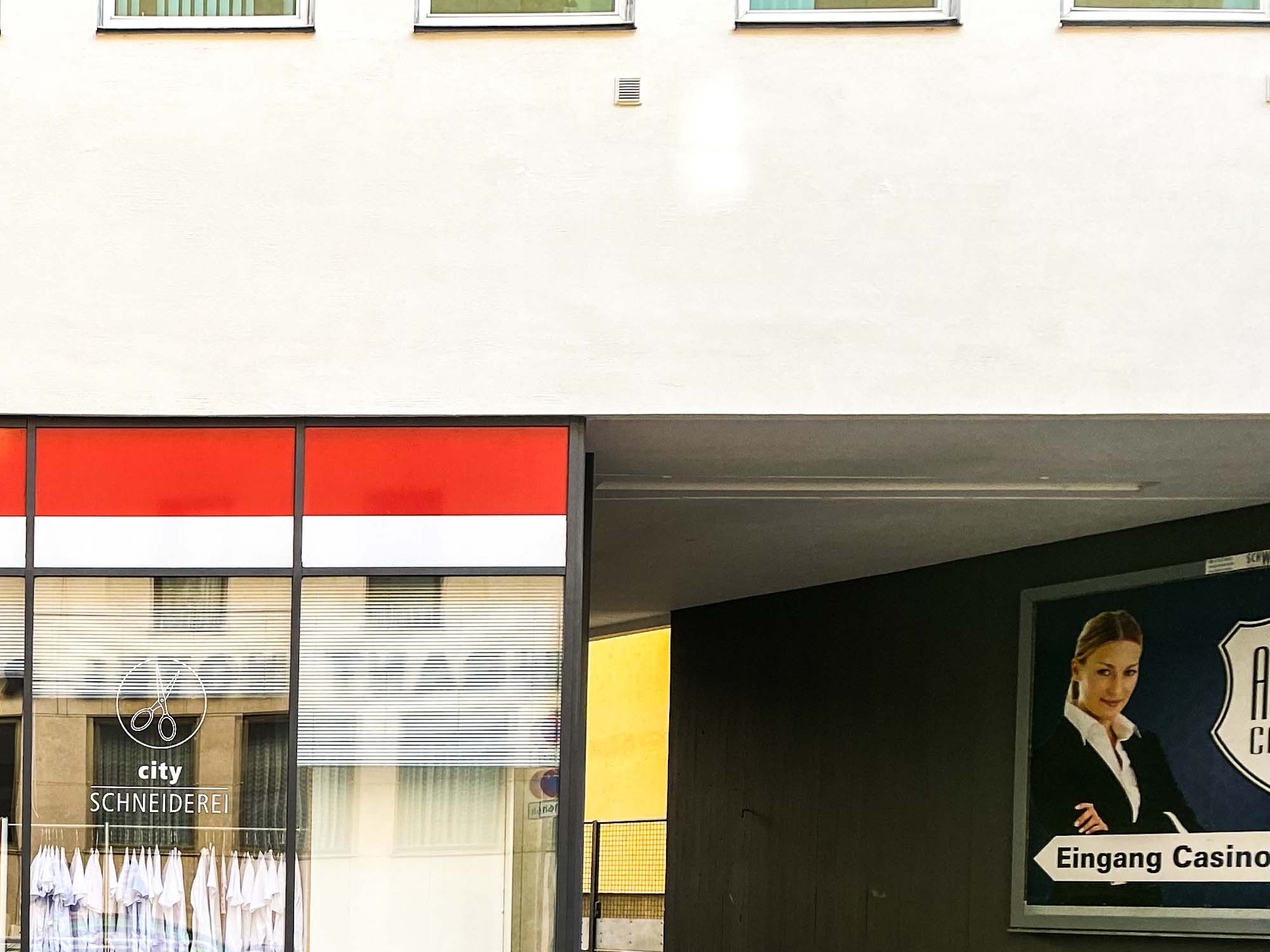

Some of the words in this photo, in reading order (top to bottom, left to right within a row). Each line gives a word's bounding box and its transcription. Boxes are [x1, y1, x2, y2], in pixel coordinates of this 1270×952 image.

[138, 760, 183, 785] city
[89, 791, 230, 815] SCHNEIDEREI
[1056, 846, 1163, 874] Eingang
[1172, 844, 1270, 869] Casino
